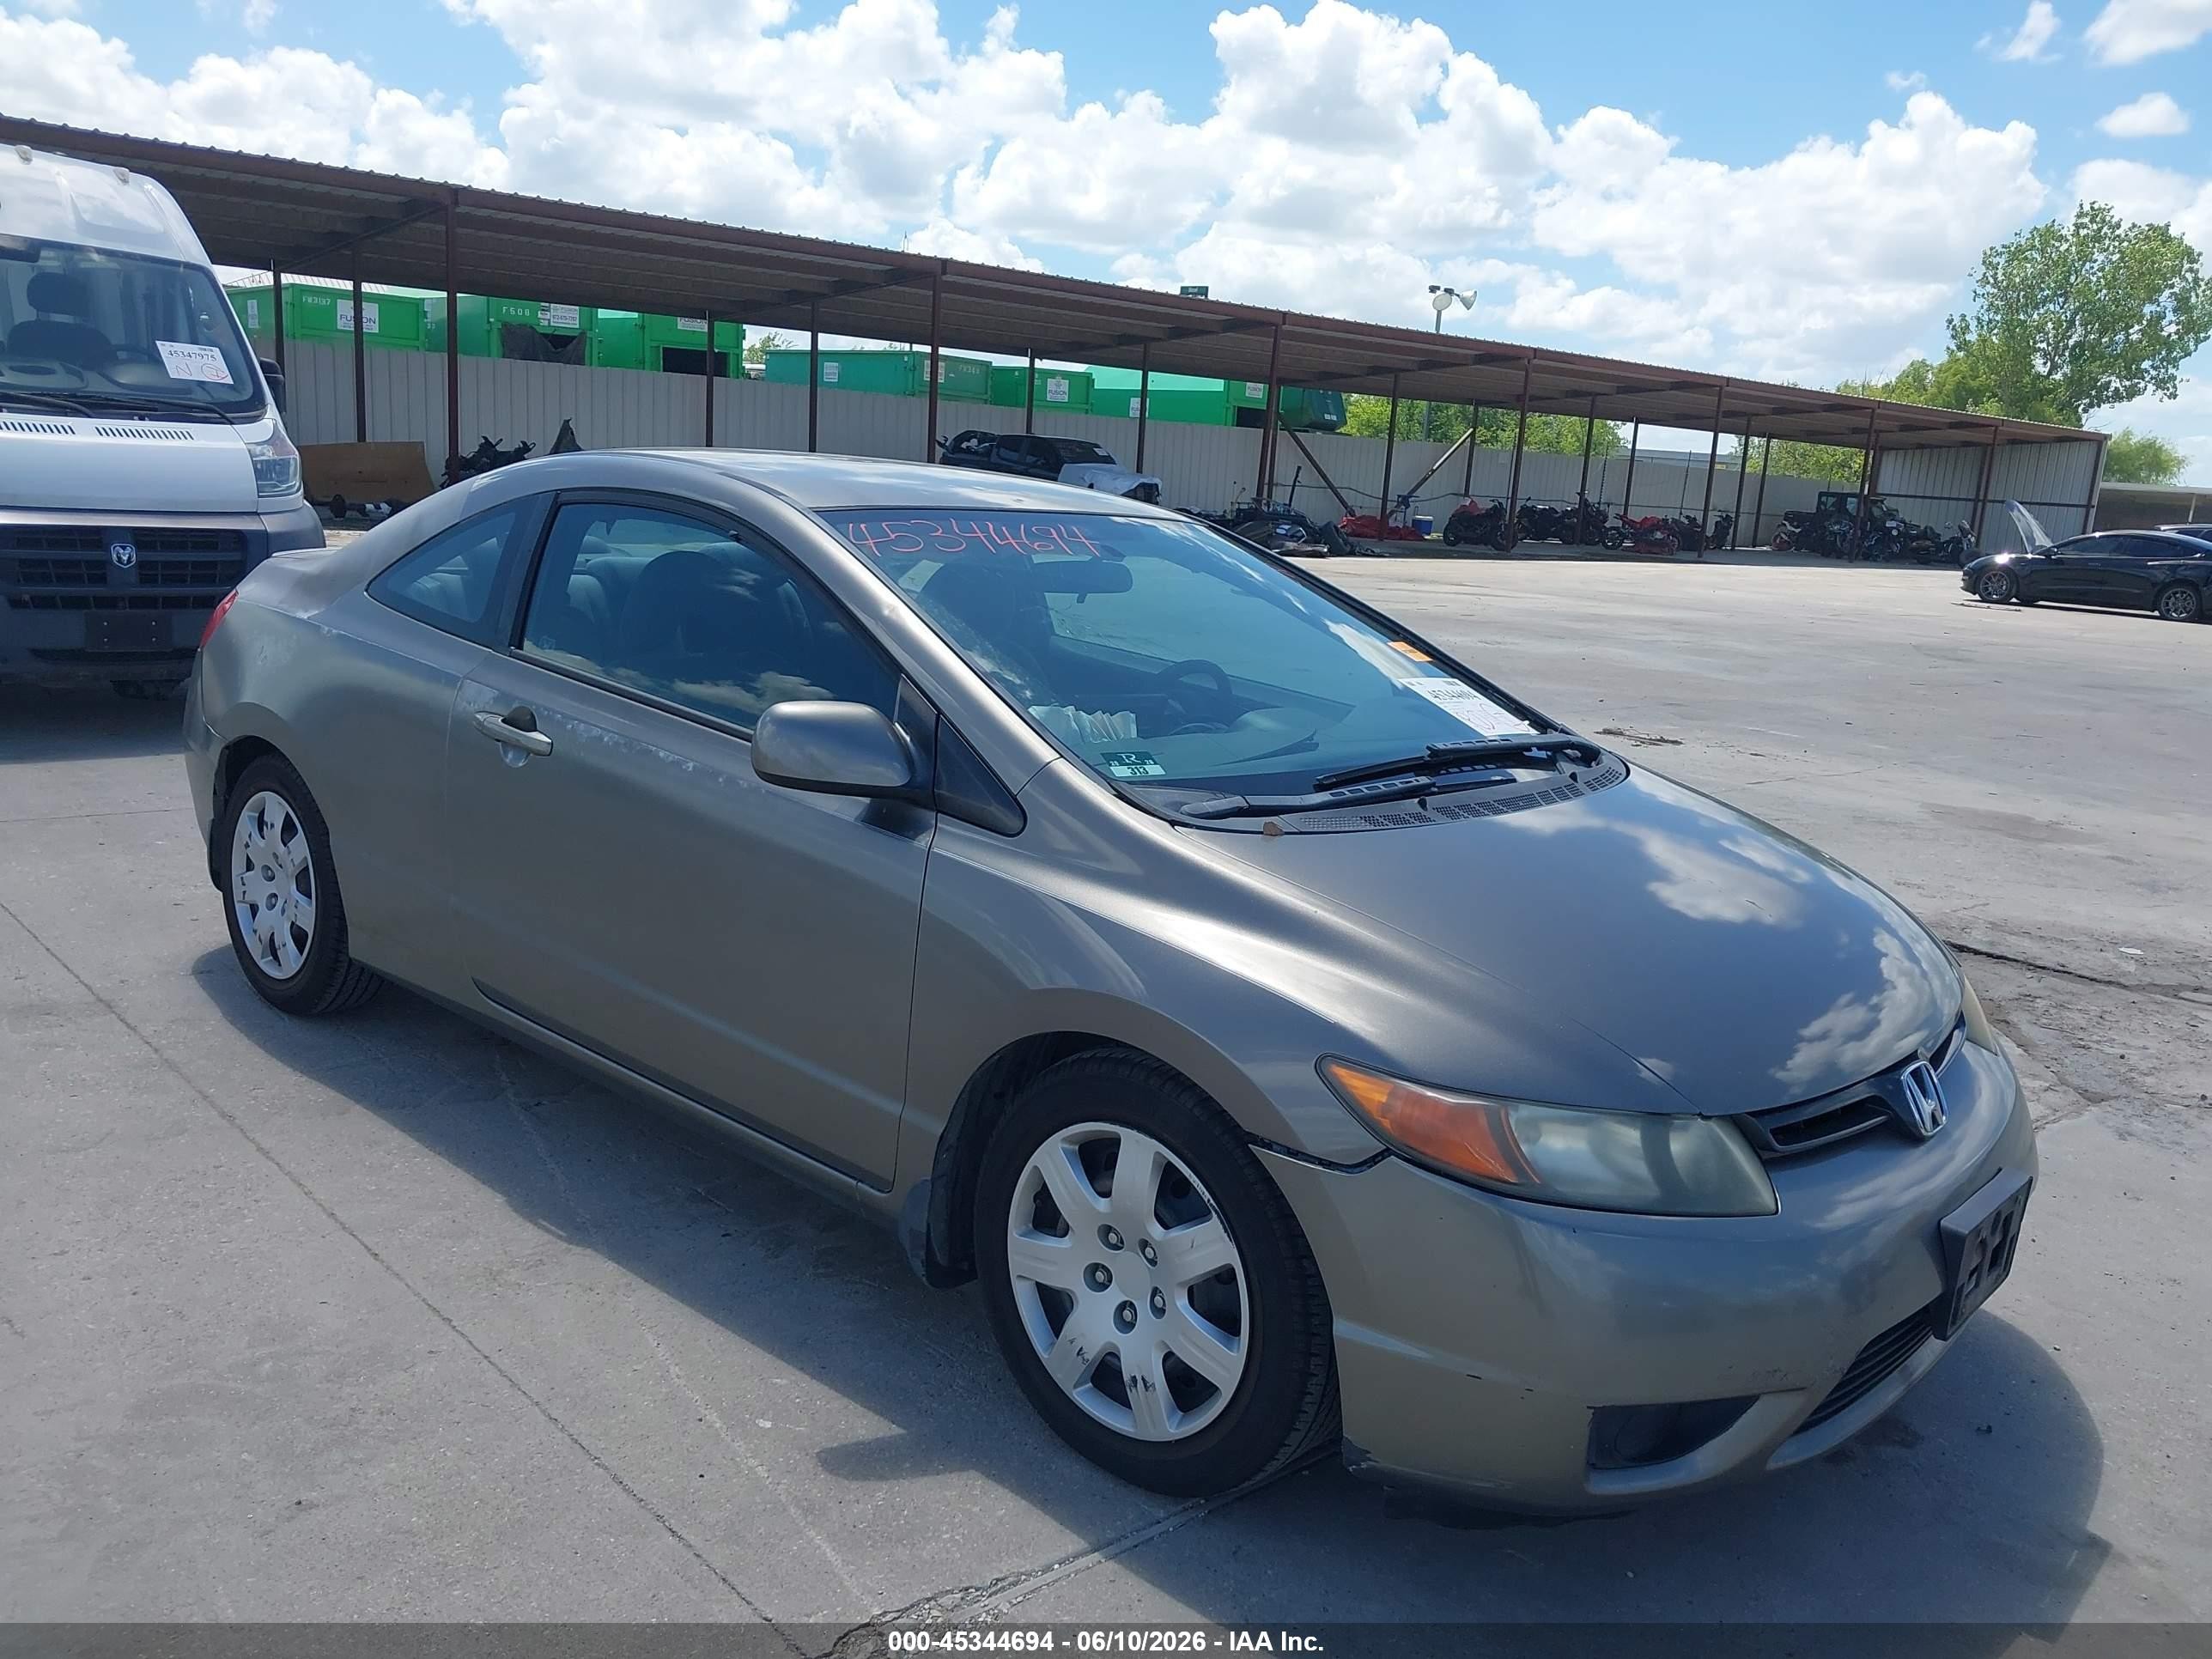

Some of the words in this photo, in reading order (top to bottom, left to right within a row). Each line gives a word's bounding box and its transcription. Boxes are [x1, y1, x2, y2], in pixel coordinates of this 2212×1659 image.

[339, 314, 376, 325] FUON
[167, 349, 217, 362] 45347975
[848, 518, 1100, 557] 45344694
[1127, 766, 1150, 775] 313
